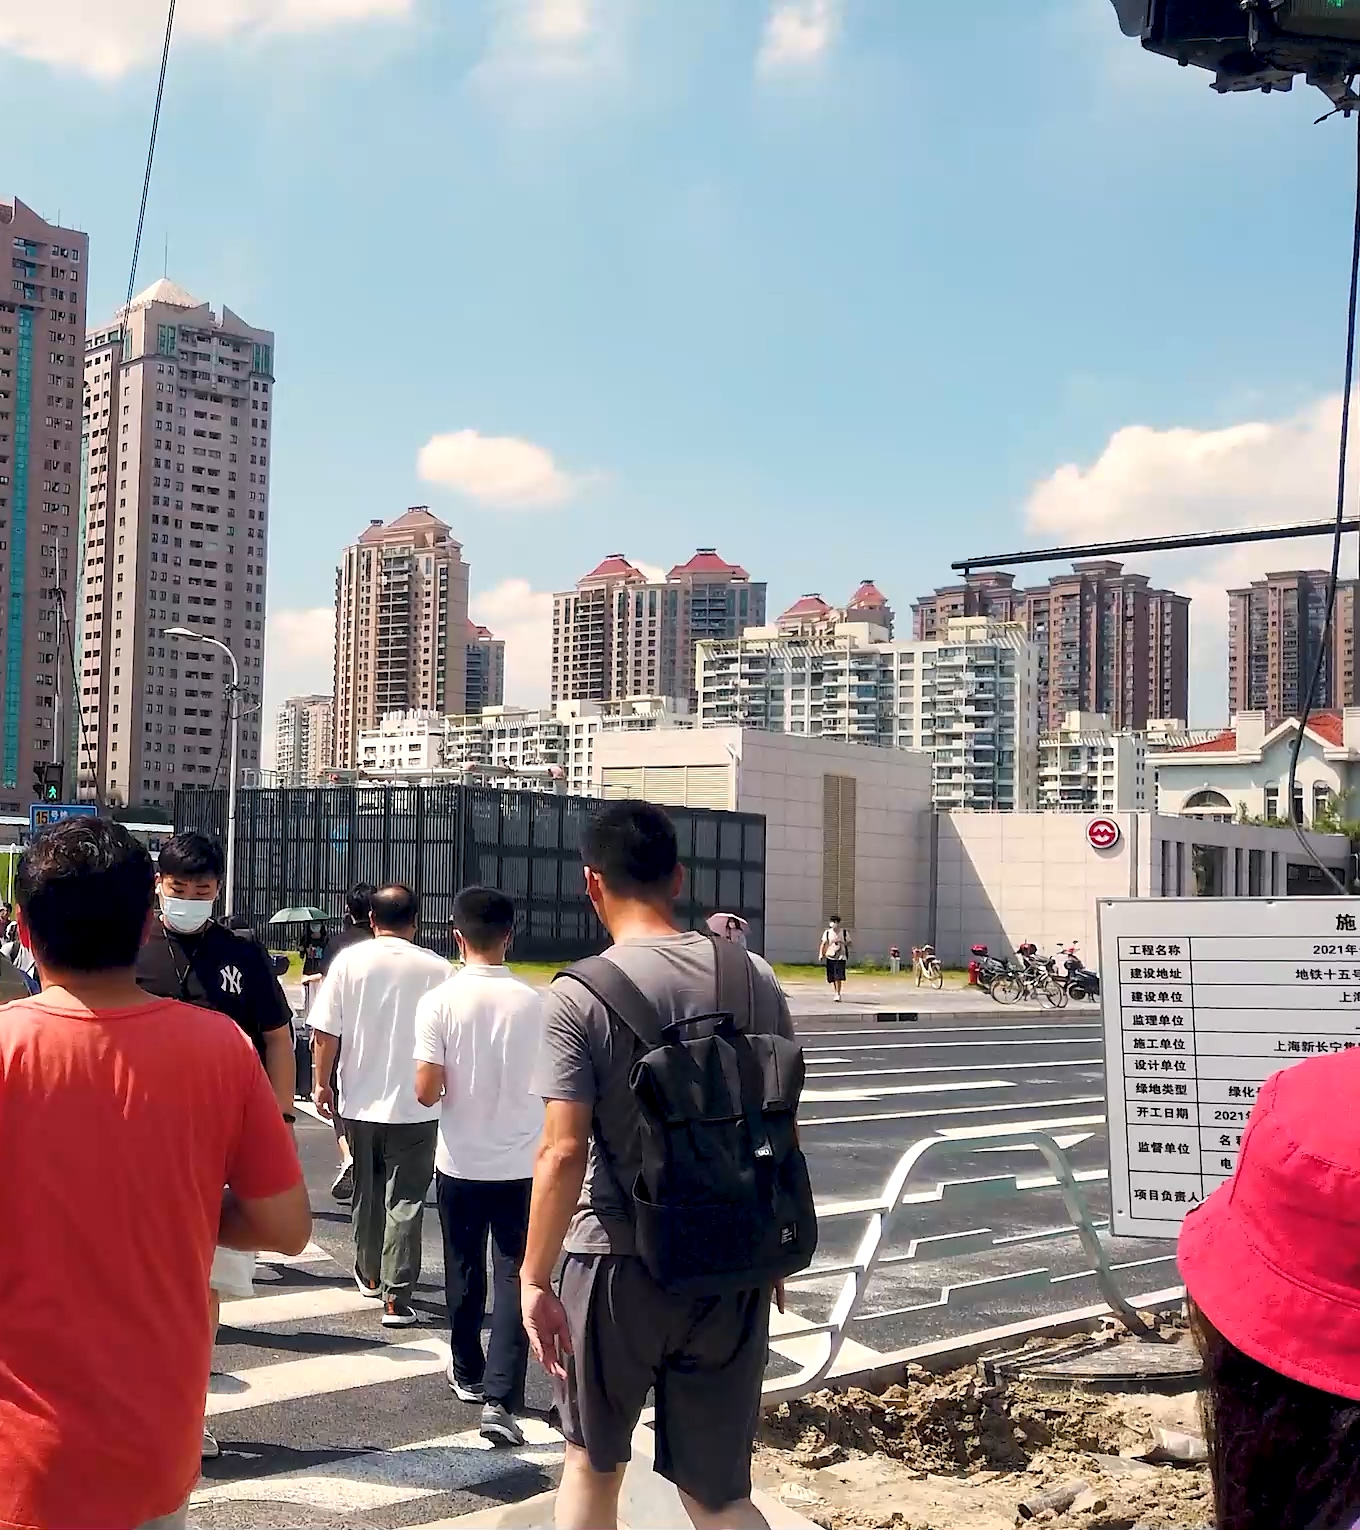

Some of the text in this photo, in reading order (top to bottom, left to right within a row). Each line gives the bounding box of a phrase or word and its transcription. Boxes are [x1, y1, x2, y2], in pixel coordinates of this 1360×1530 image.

[36, 811, 48, 824] 15
[1129, 944, 1181, 956] 工程名称
[1312, 944, 1360, 955] 2021年
[1130, 968, 1182, 979] 建设地址
[1131, 991, 1184, 1003] 建设单位
[1132, 1014, 1185, 1026] 监理单位
[1133, 1038, 1186, 1050] 施工单位
[1273, 1040, 1360, 1053] 上海新长宁
[1134, 1059, 1187, 1072] 设计单位
[1135, 1082, 1188, 1096] 绿地类型
[1228, 1085, 1261, 1098] 绿化
[1136, 1106, 1189, 1120] 开工日期
[1138, 1141, 1190, 1155] 监督单位
[1220, 1157, 1232, 1170] 电
[1134, 1188, 1200, 1204] 项目负责人
